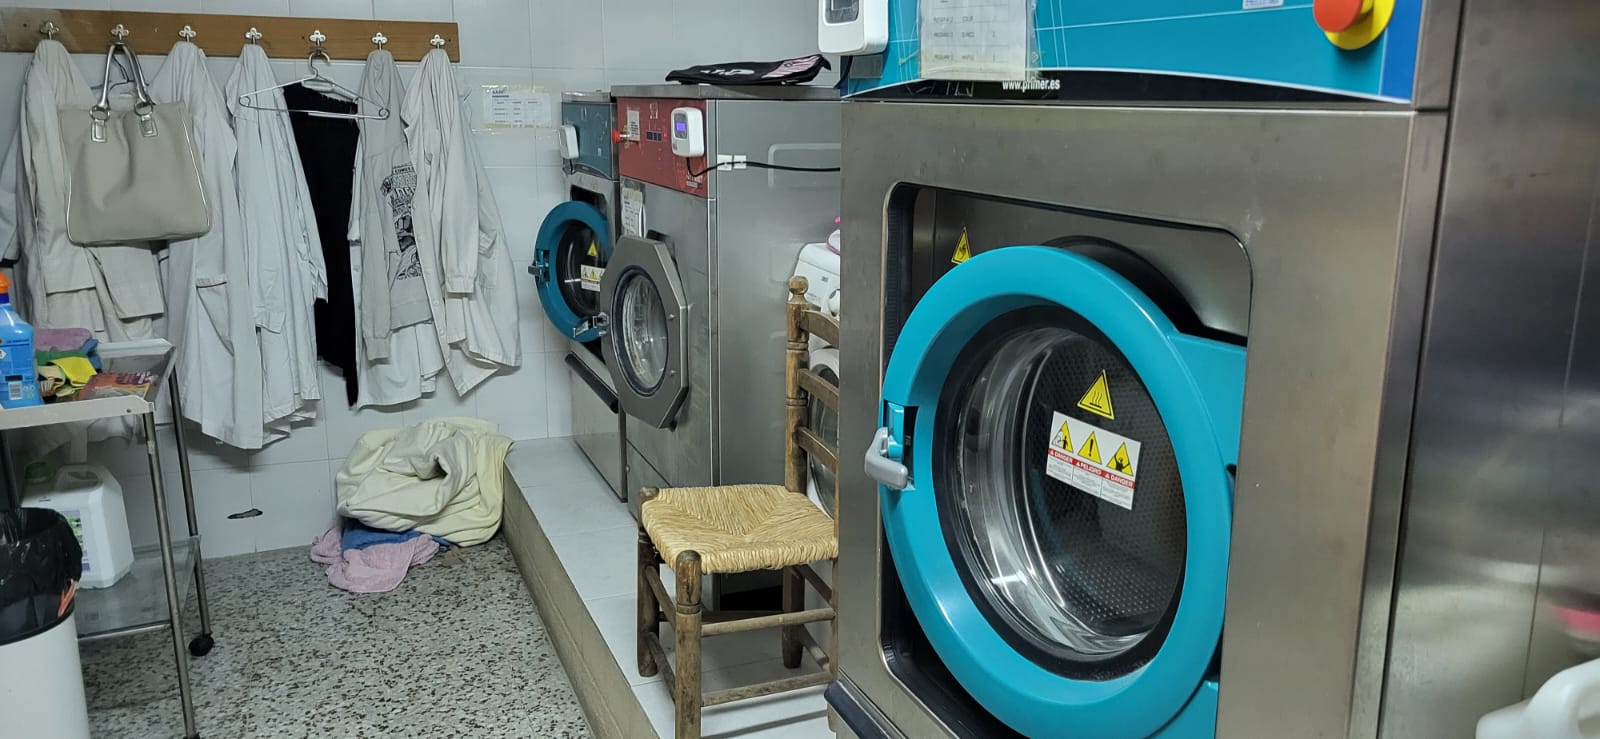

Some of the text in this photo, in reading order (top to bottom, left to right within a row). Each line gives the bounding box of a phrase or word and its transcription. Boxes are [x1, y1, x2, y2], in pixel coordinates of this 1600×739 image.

[1002, 79, 1061, 93] www.primer.es
[1054, 451, 1073, 464] DANGER
[1111, 472, 1134, 487] DANGER
